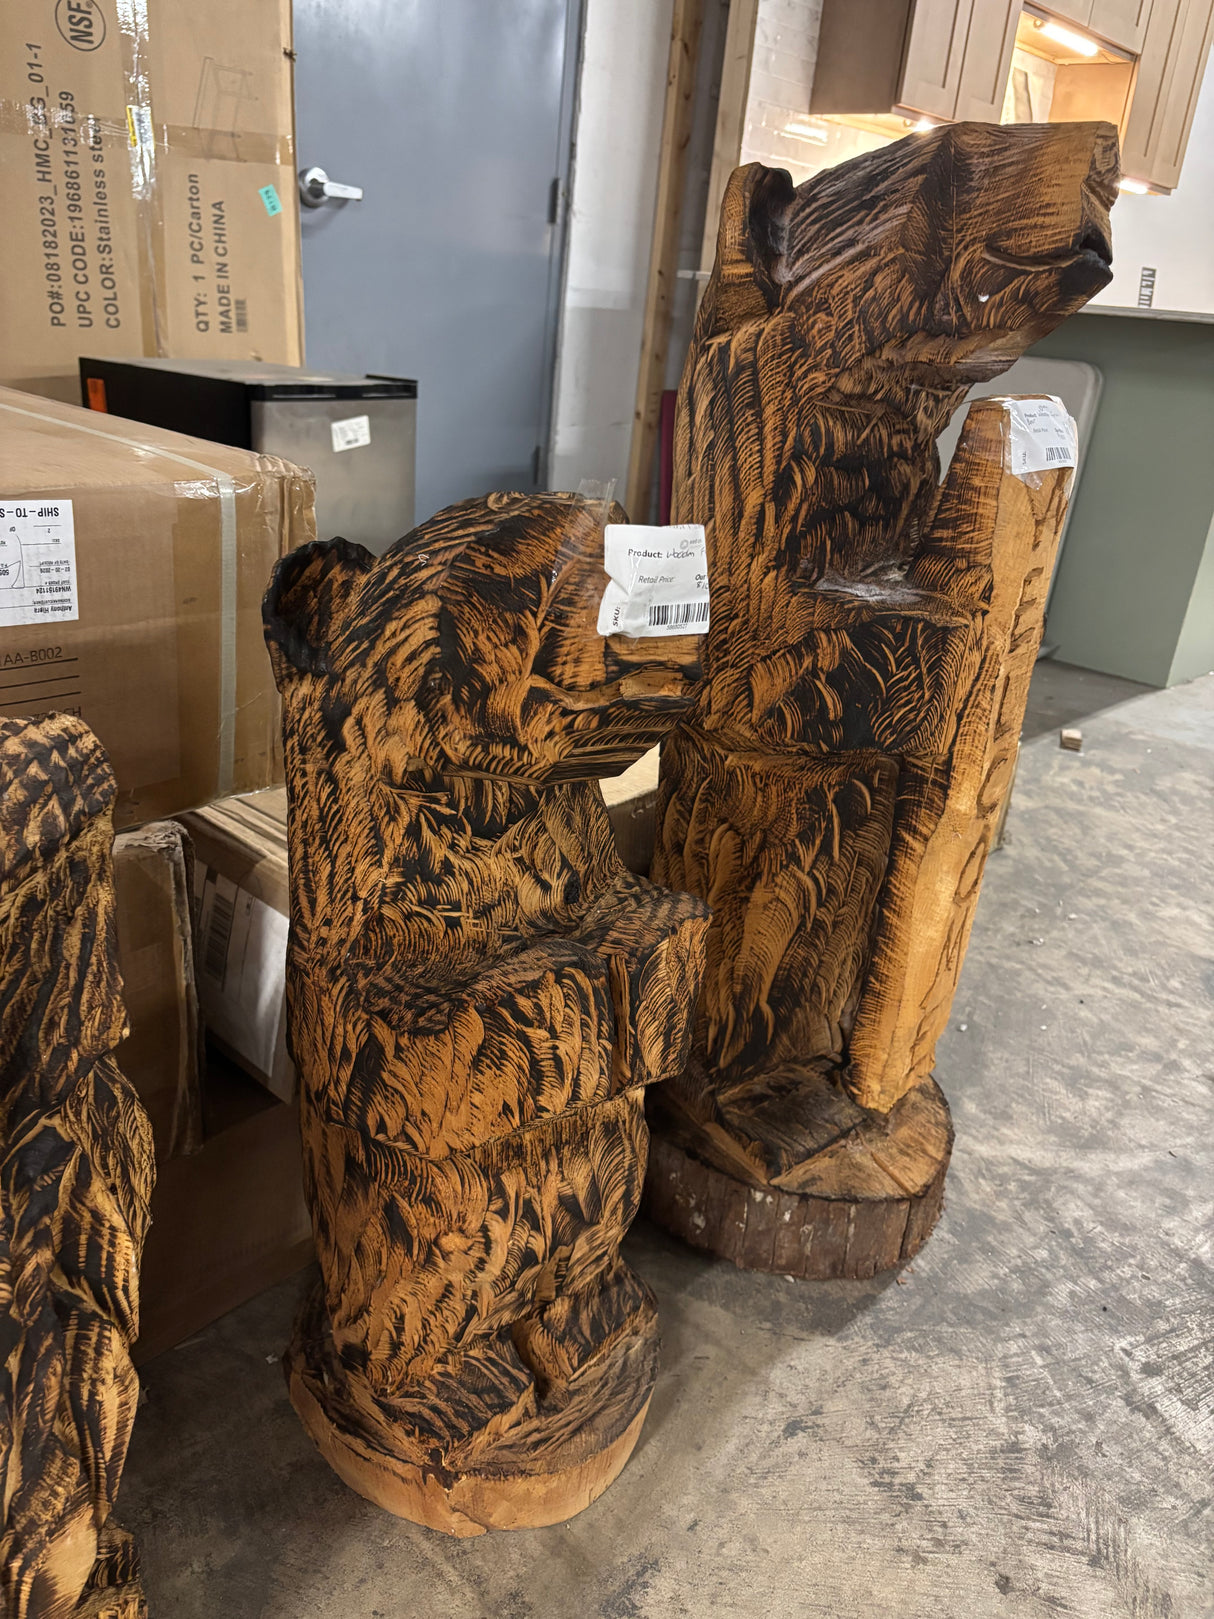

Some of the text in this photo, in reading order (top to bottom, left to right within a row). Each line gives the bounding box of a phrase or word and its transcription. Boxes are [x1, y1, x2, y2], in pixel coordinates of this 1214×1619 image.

[67, 0, 94, 44] NSF
[92, 168, 120, 329] COLOR:Stainless
[187, 173, 210, 333] QTY: 1 PC/Carton
[212, 201, 233, 334] MADE IN CHINA
[75, 290, 93, 328] UPC
[628, 548, 663, 559] Product:
[612, 607, 621, 627] SKU:
[0, 646, 63, 667] AA-B002
